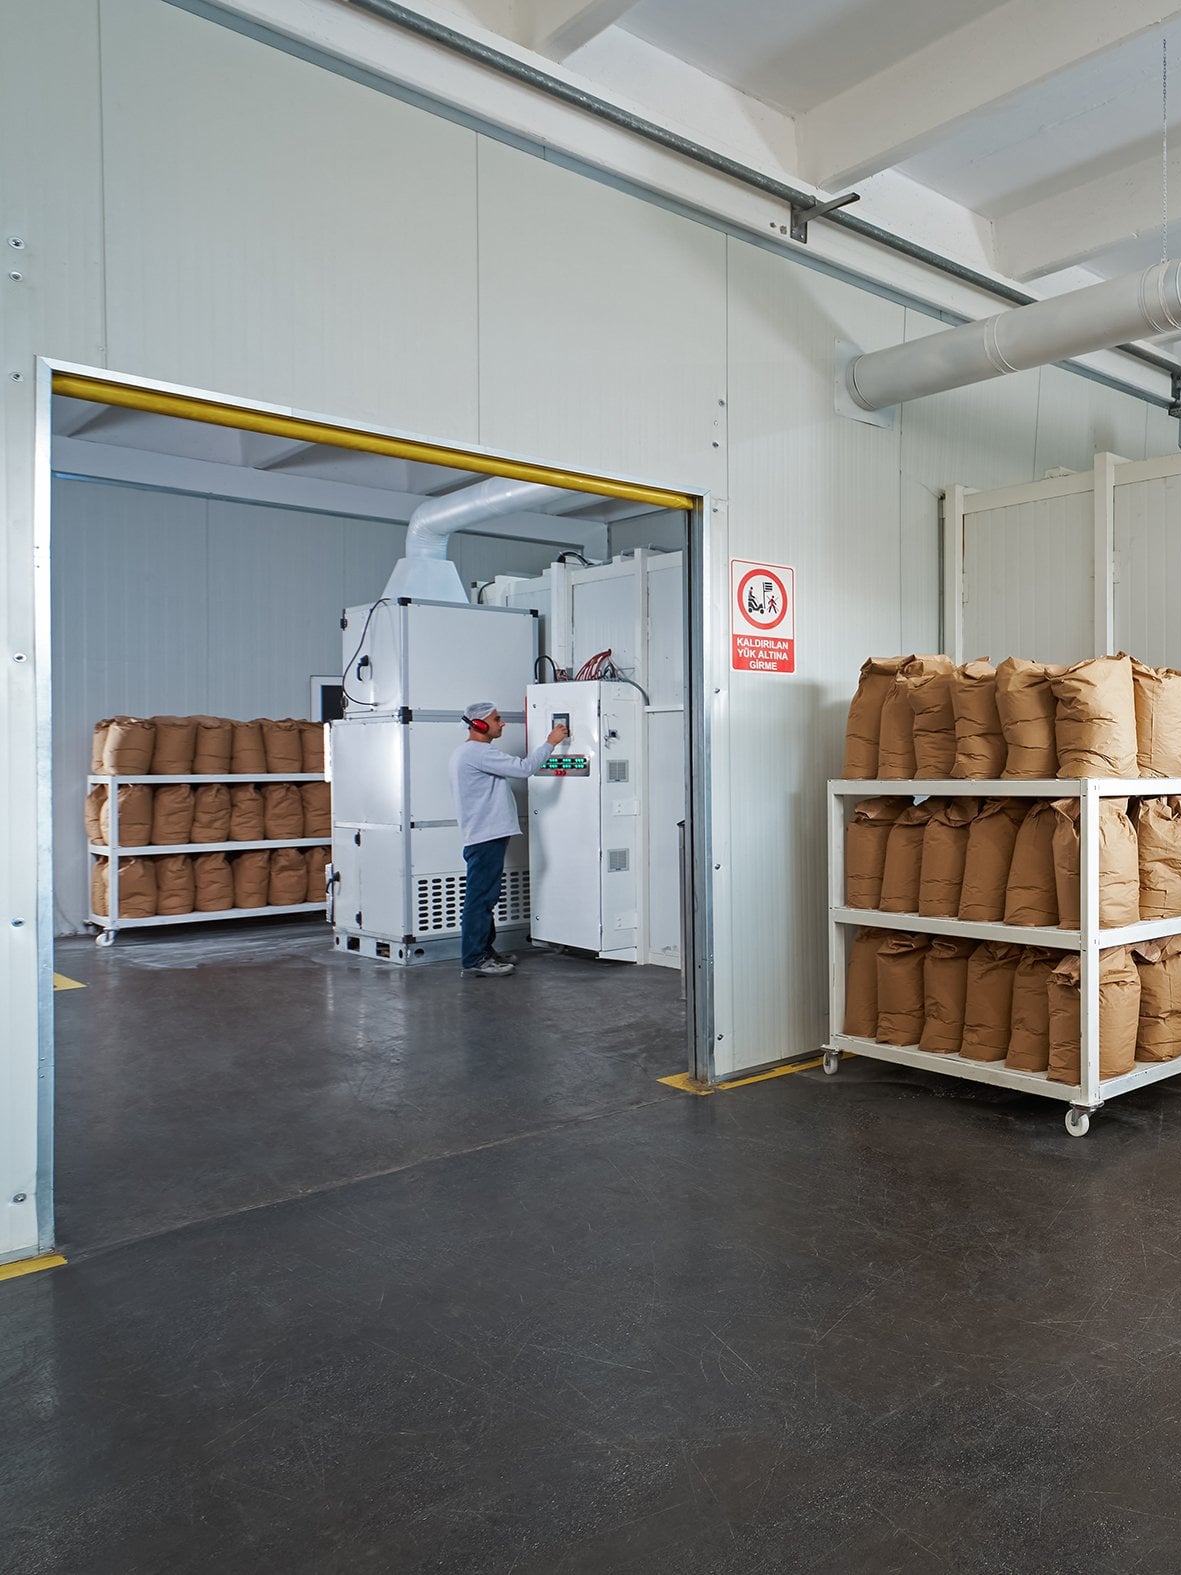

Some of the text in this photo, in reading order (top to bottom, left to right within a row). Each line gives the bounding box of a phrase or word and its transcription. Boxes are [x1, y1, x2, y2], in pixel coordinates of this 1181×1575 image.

[736, 637, 789, 650] KALDIRILAN
[737, 647, 789, 661] YÜK ALTINA
[749, 659, 778, 670] GİRME
